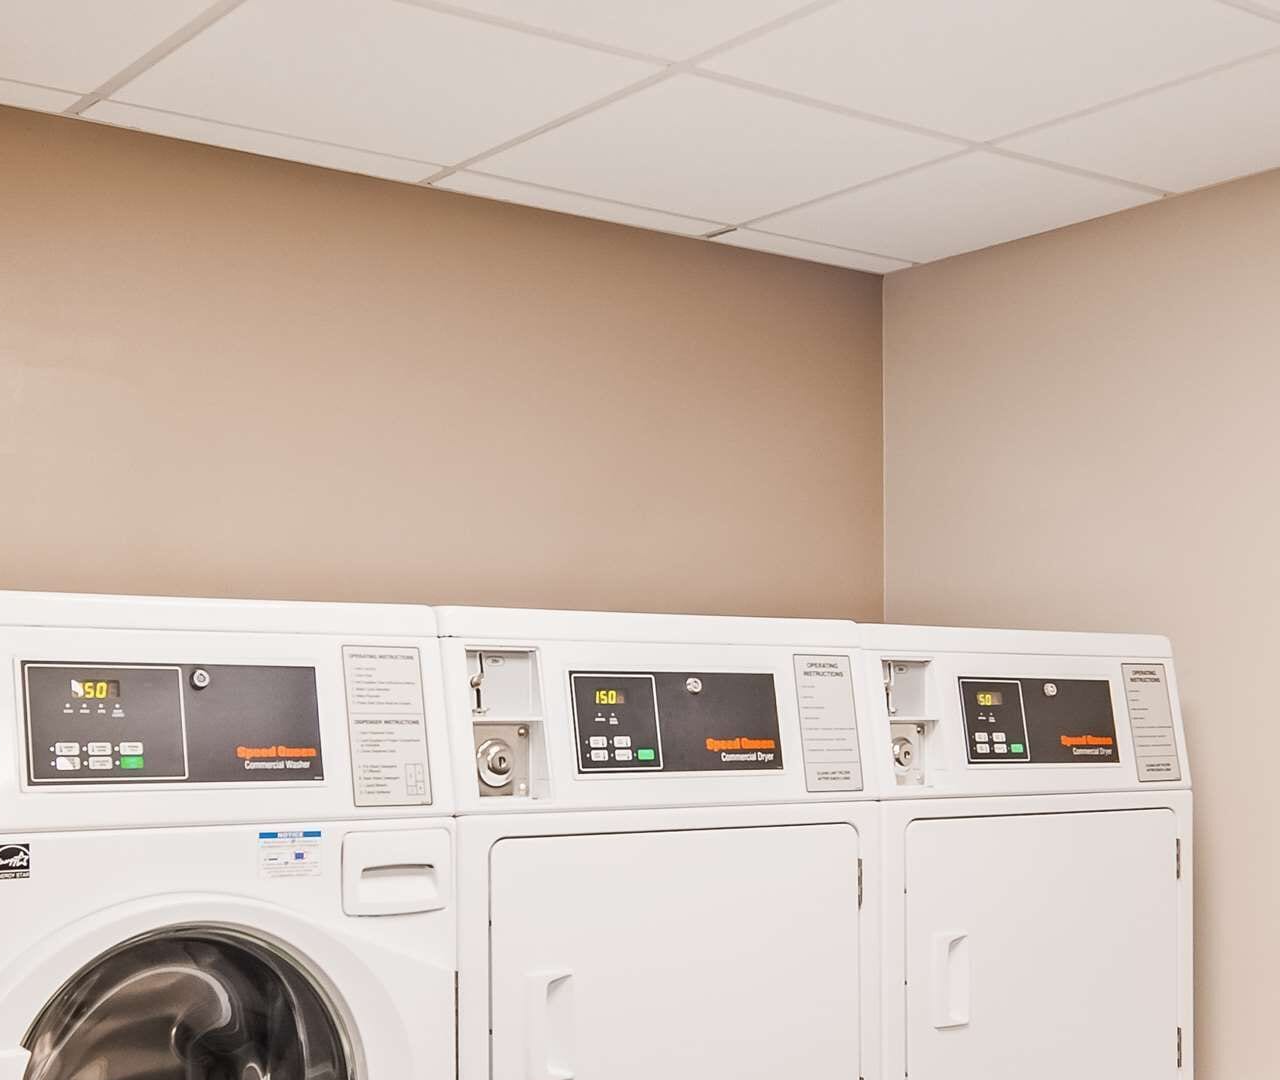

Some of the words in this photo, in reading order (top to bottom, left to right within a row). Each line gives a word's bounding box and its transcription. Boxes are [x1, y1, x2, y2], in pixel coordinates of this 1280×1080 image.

[757, 752, 774, 762] Dryer
[244, 760, 284, 769] Commercial
[286, 760, 310, 769] Washer
